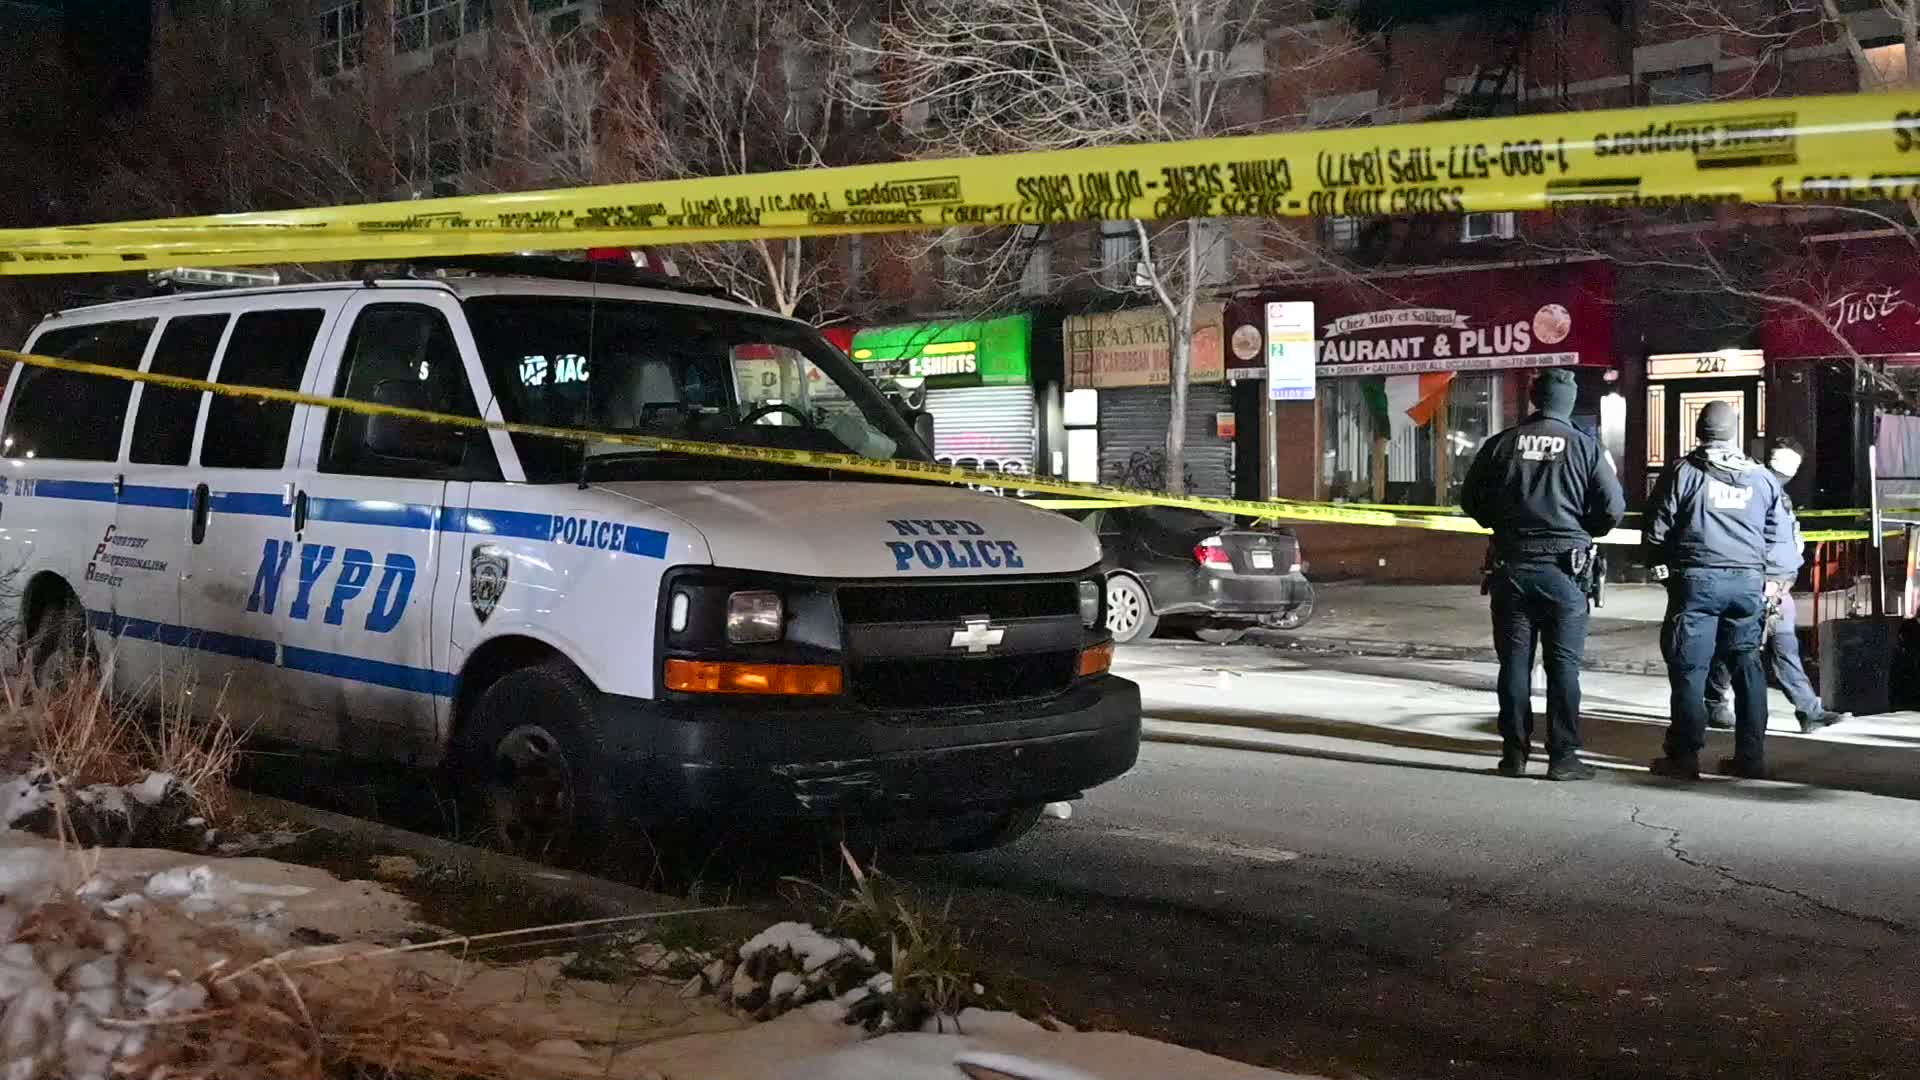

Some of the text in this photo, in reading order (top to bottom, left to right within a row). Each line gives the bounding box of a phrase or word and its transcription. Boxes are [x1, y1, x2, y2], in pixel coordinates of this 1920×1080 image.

[1388, 137, 1568, 184] 1-800-577-TIPS
[1016, 175, 1075, 203] CROSS
[1079, 171, 1112, 200] NOT
[1116, 169, 1143, 198] DO
[1161, 163, 1224, 200] SCENE
[1229, 157, 1292, 194] CRIME
[844, 181, 917, 207] stoppers
[1338, 318, 1365, 332] Chez
[1432, 333, 1452, 358] &
[1459, 320, 1532, 356] PLUS
[1696, 357, 1727, 374] 2247
[1517, 434, 1566, 454] NYPD
[550, 514, 625, 553] POLICE
[886, 519, 985, 536] NYPD
[885, 539, 1025, 571] POLICE
[246, 538, 417, 634] NYPD
